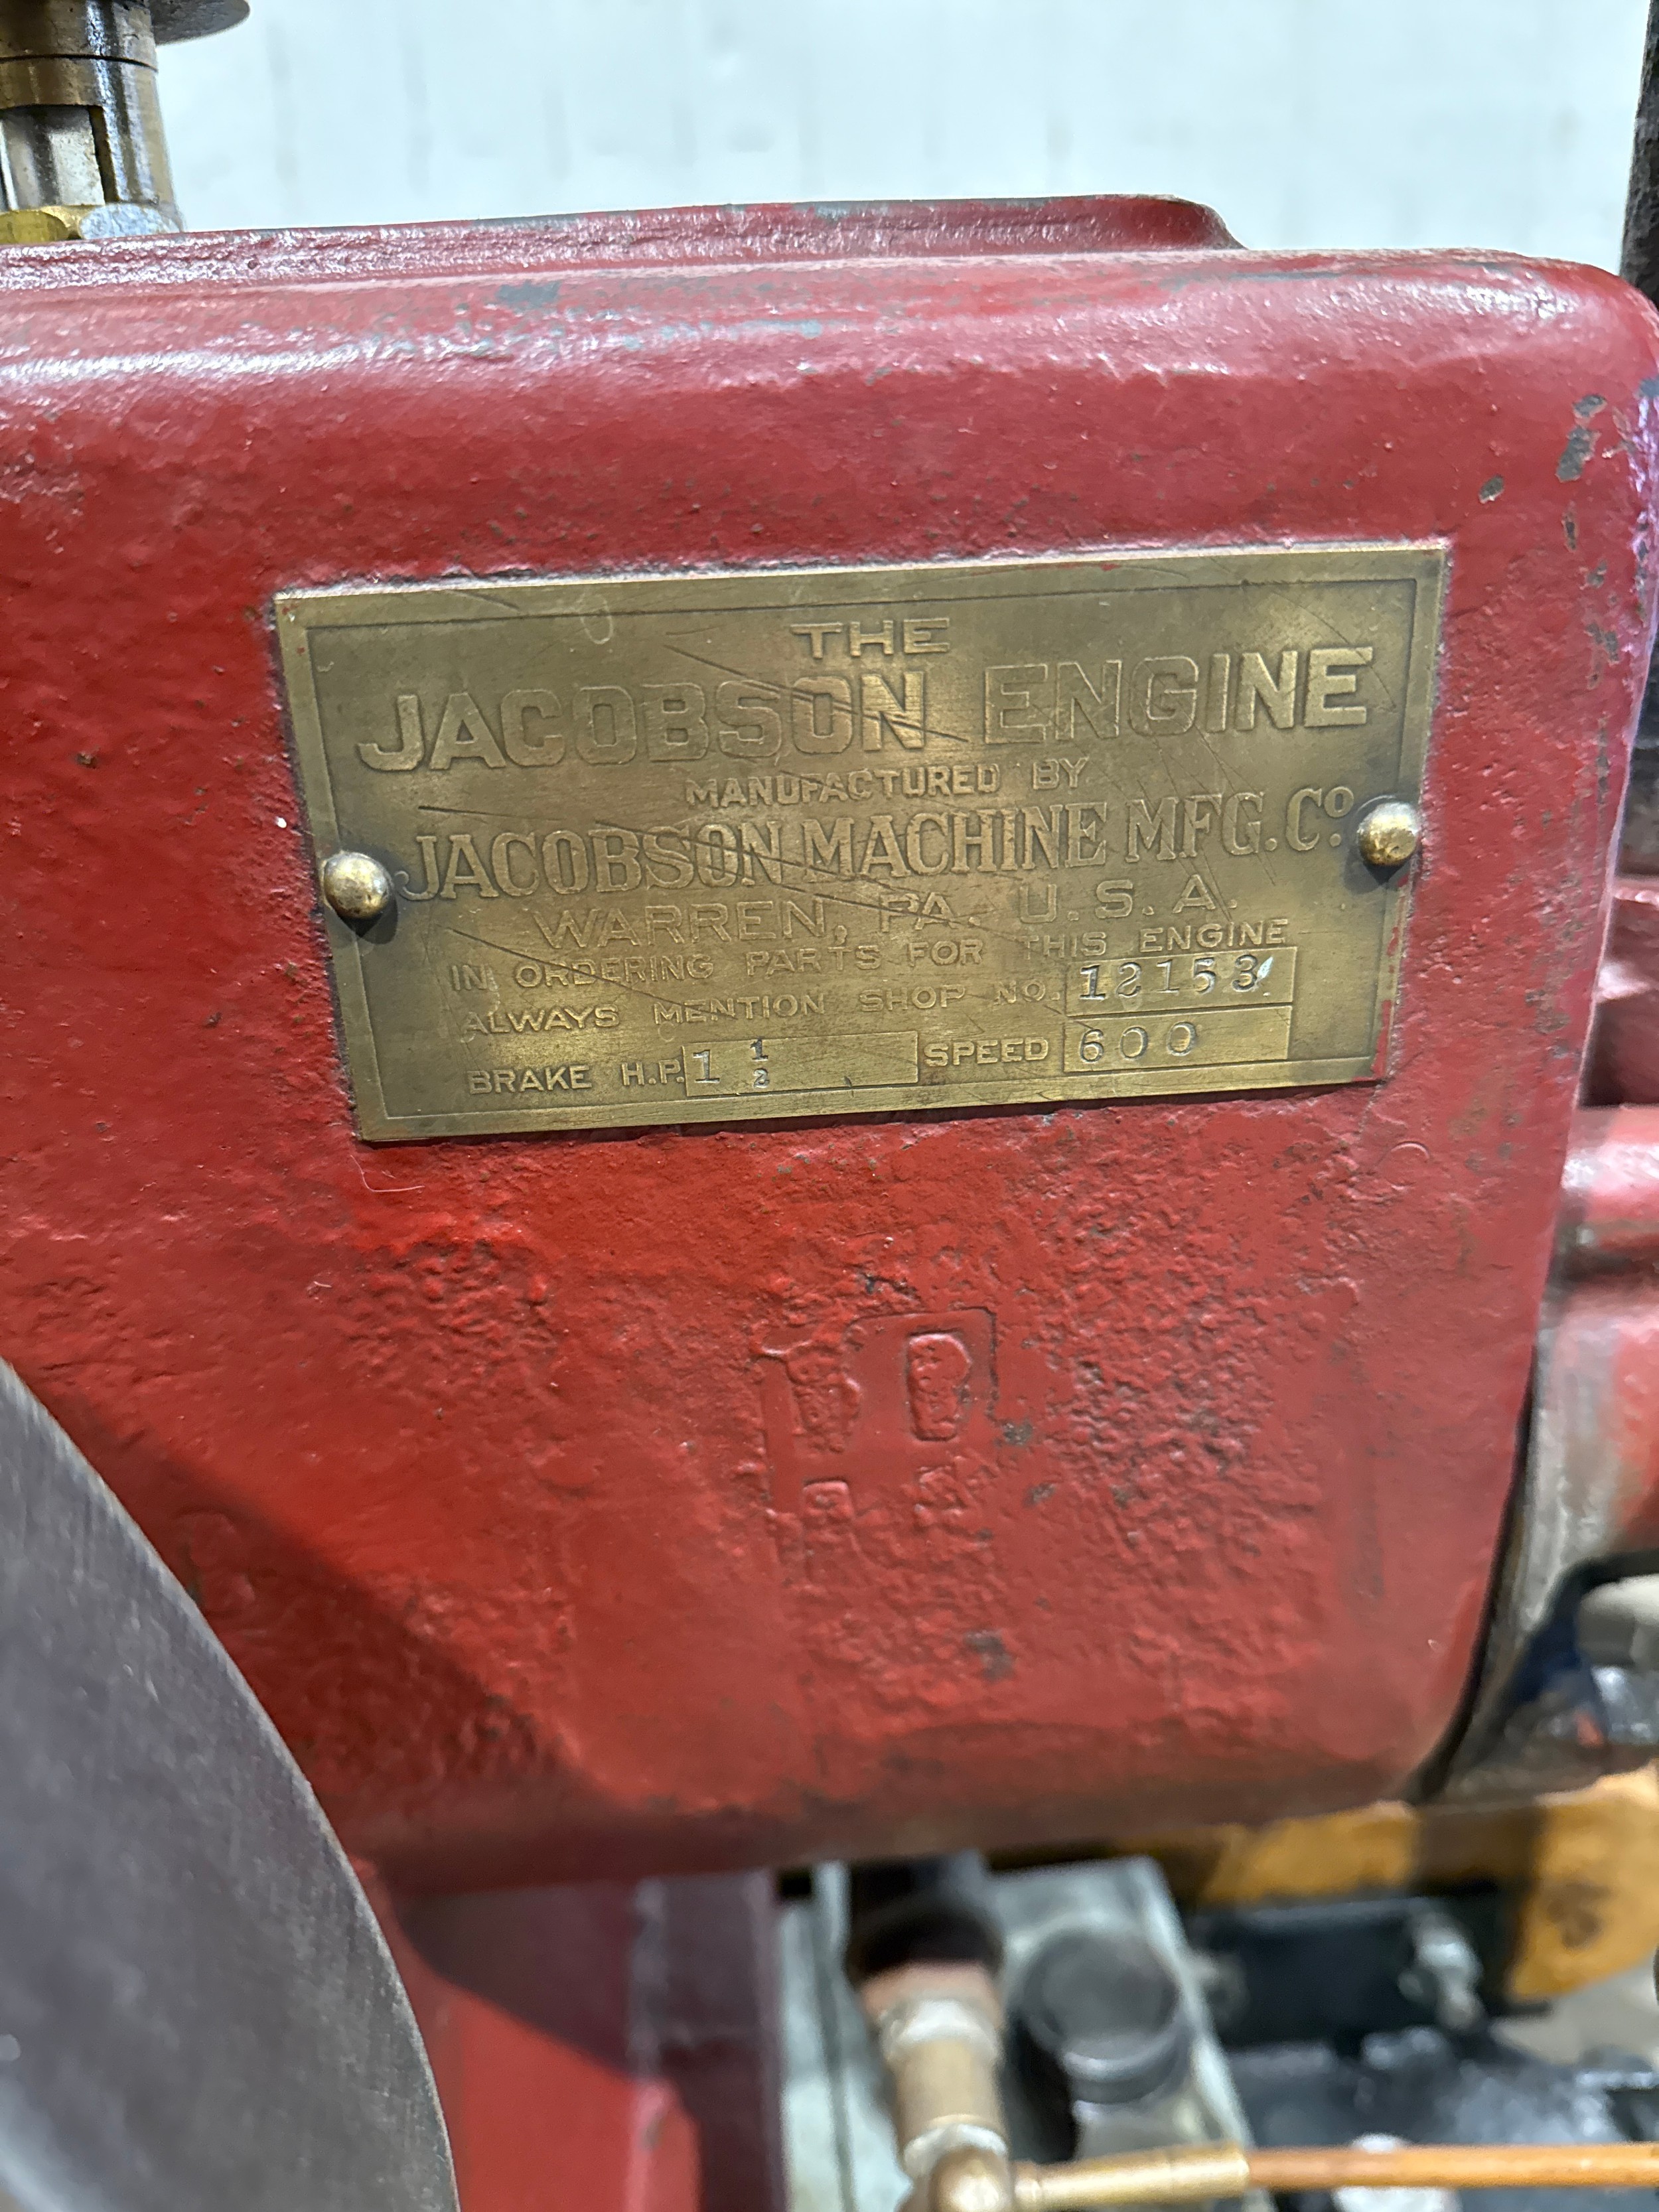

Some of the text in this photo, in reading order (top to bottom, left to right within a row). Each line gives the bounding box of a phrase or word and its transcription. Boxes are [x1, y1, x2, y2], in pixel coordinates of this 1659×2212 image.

[790, 616, 951, 661] THE
[356, 646, 1374, 773] JACOBSON ENGINE
[685, 756, 1090, 809] MANUFACTURED BY
[396, 819, 784, 901] JACOBSON
[800, 801, 1109, 880] MACHINE
[451, 917, 1289, 992] IN ORDERING PARTS FOR THIS ENGINE
[463, 1003, 620, 1035] ALWAYS
[654, 992, 825, 1025] MENTION
[859, 985, 966, 1011] SHOP
[1079, 954, 1261, 1001] 12153
[923, 1021, 1198, 1067] SPEED 600
[468, 1063, 593, 1095] BRAKE
